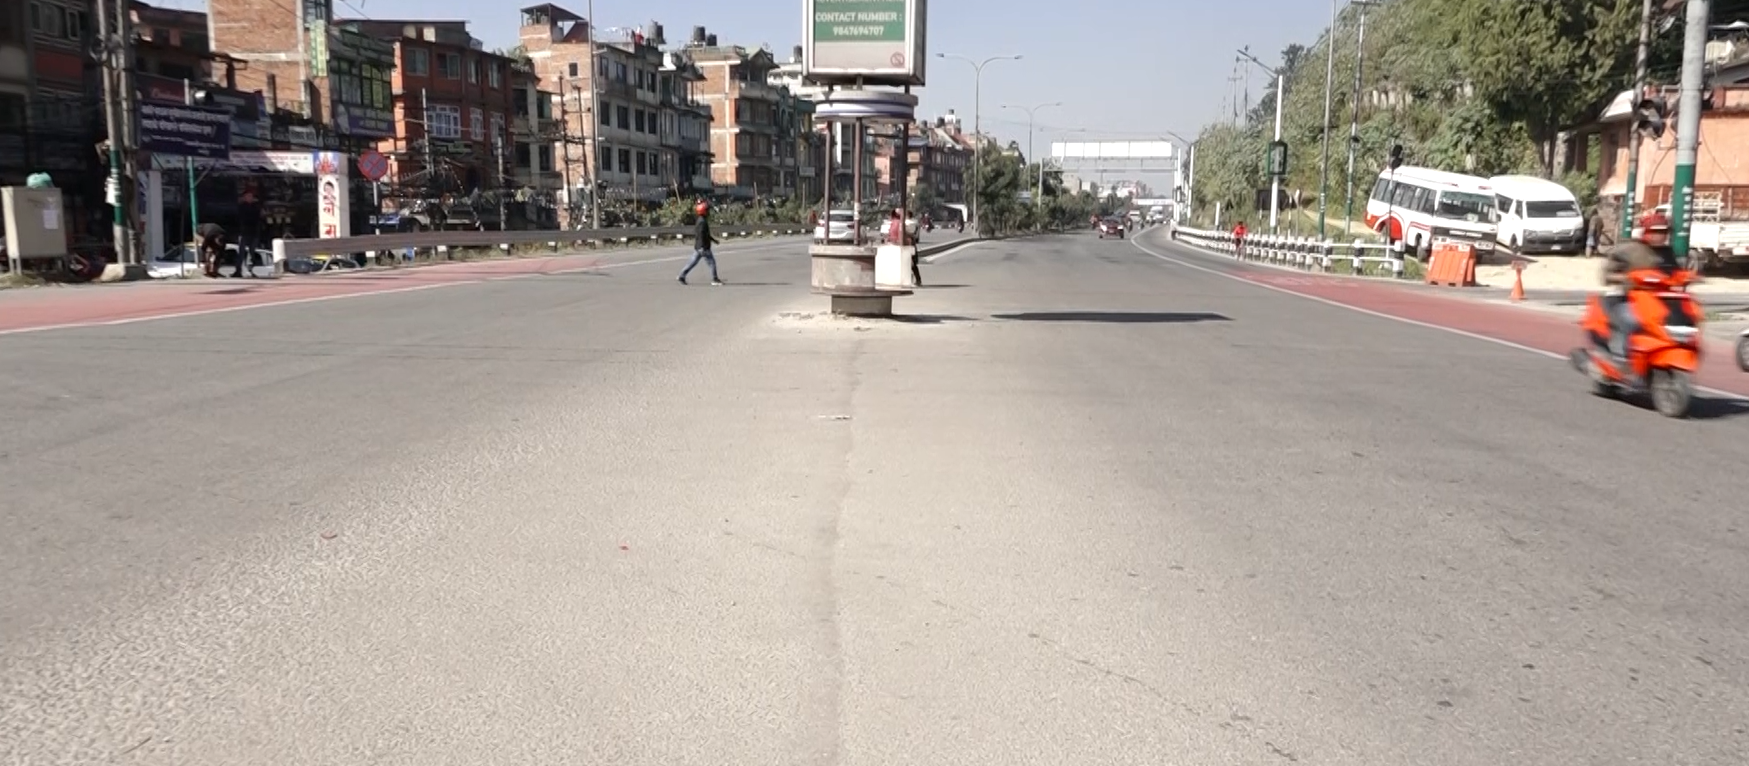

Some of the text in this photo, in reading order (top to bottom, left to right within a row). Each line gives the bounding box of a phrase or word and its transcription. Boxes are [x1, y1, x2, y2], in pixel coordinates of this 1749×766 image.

[815, 12, 855, 23] CONTACT
[857, 12, 898, 23] NUMBER
[832, 26, 885, 36] 9847694707
